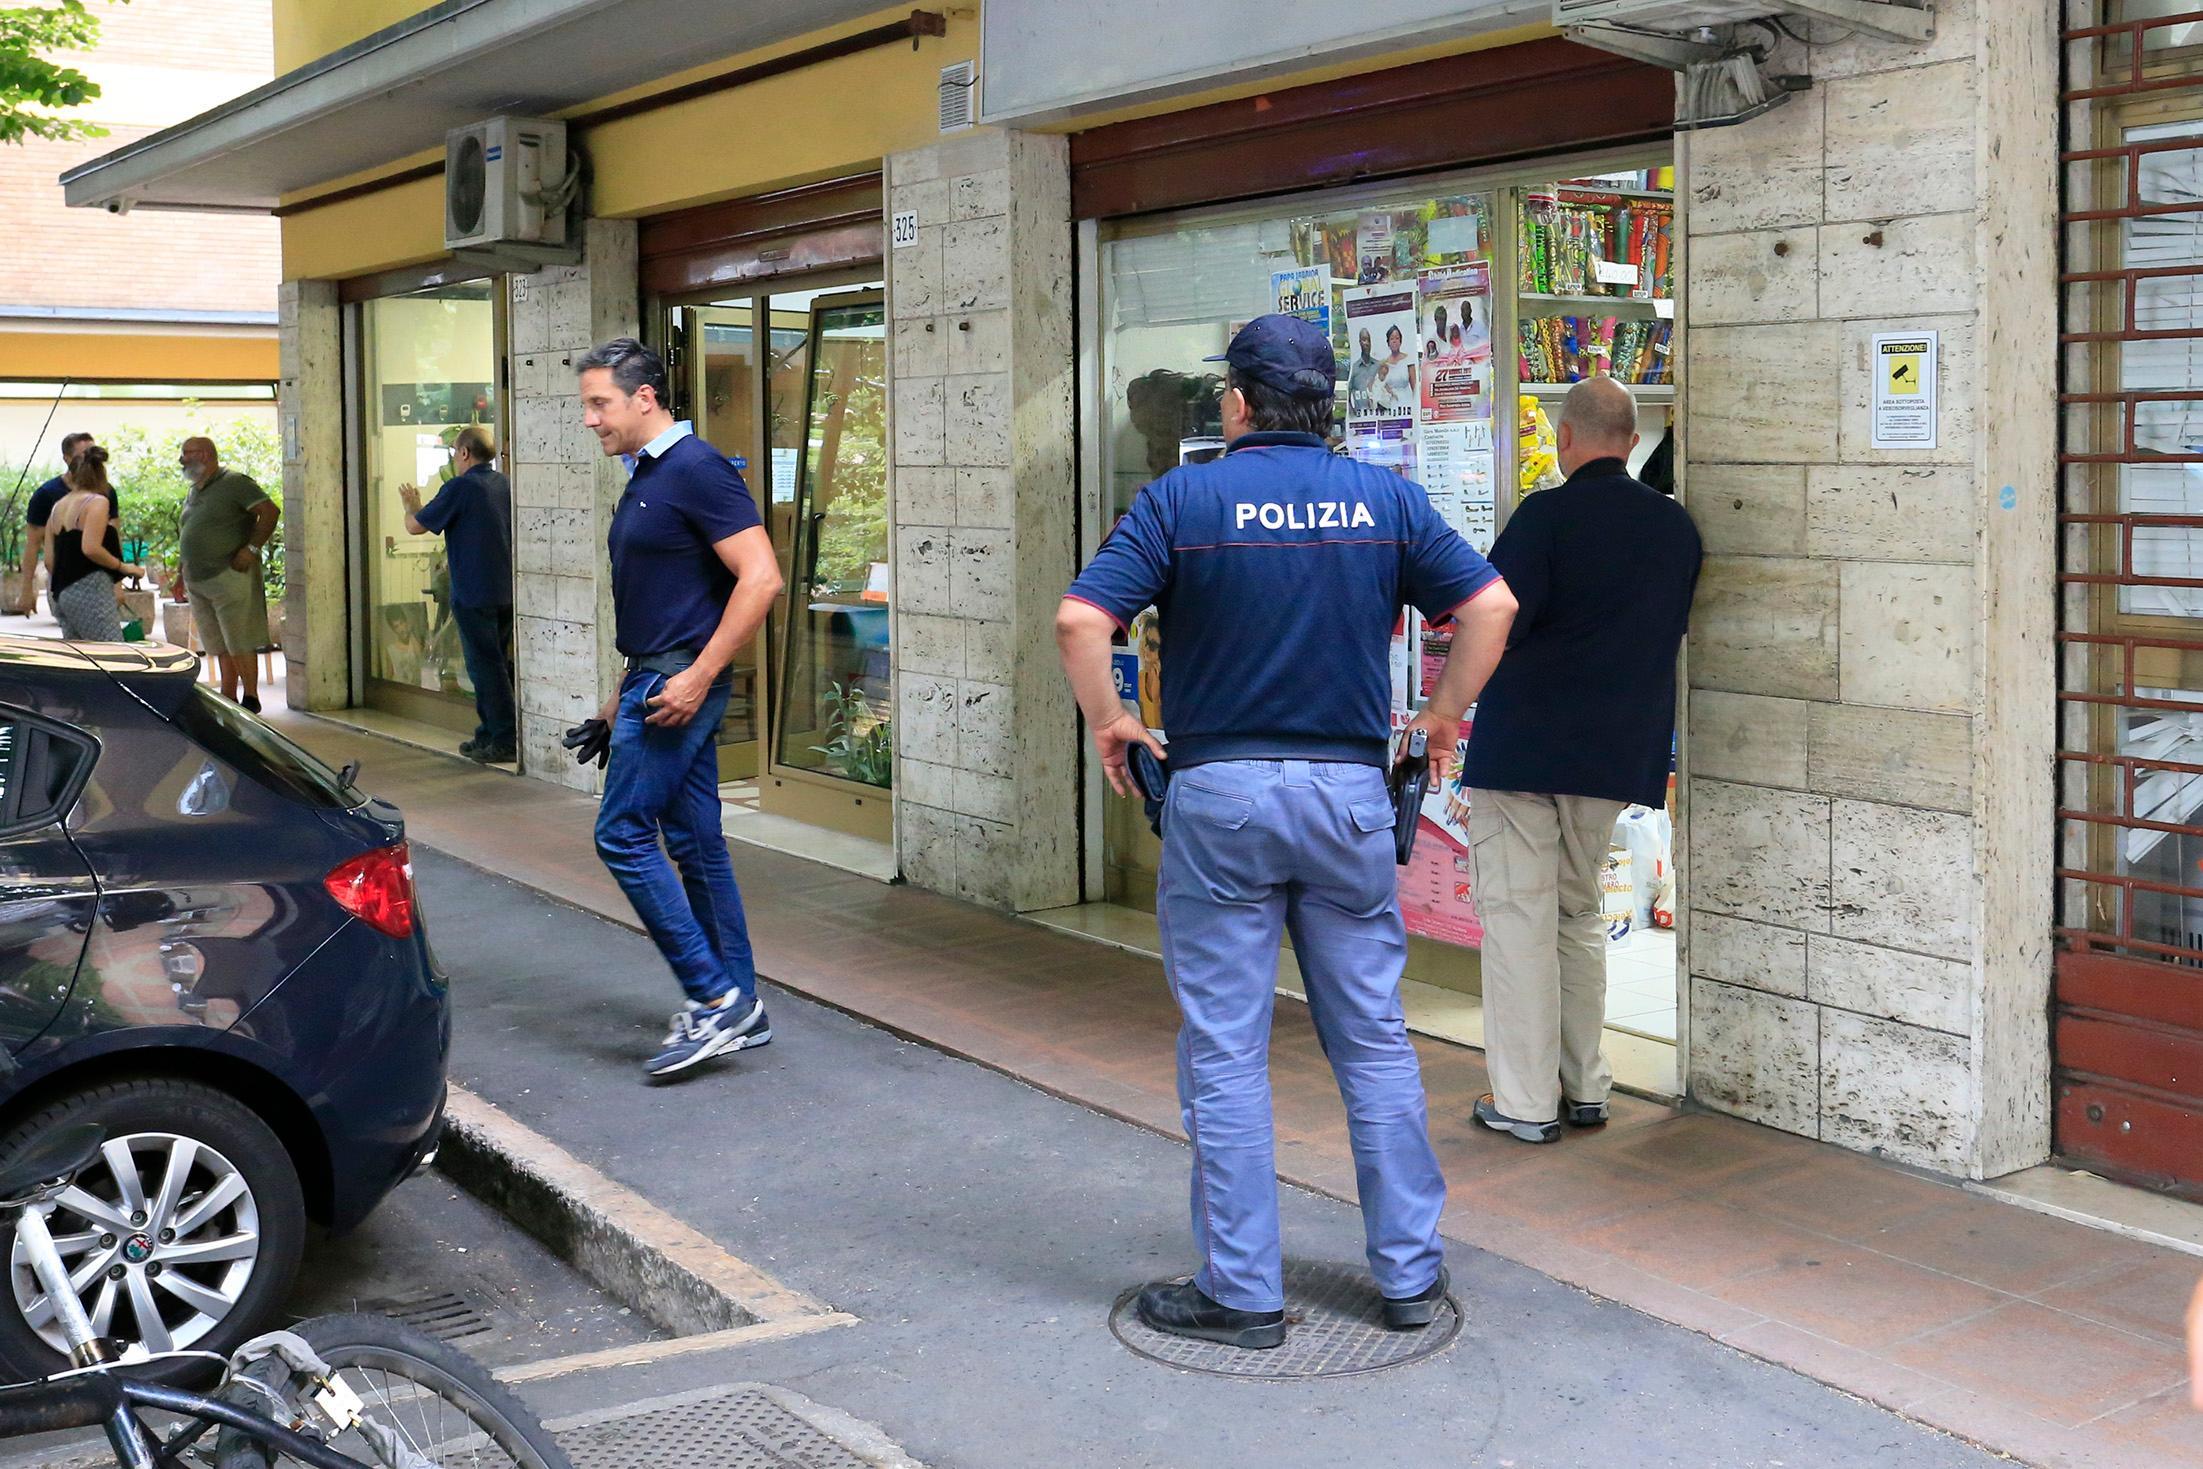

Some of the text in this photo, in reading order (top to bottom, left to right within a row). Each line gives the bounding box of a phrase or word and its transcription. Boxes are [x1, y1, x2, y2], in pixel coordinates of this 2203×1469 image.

[895, 215, 916, 242] 325
[515, 279, 526, 298] 323
[1278, 290, 1325, 313] SERVICE
[1882, 344, 1927, 353] ATTENZIONE!
[1435, 369, 1448, 382] 27
[1236, 502, 1375, 530] POLIZIA
